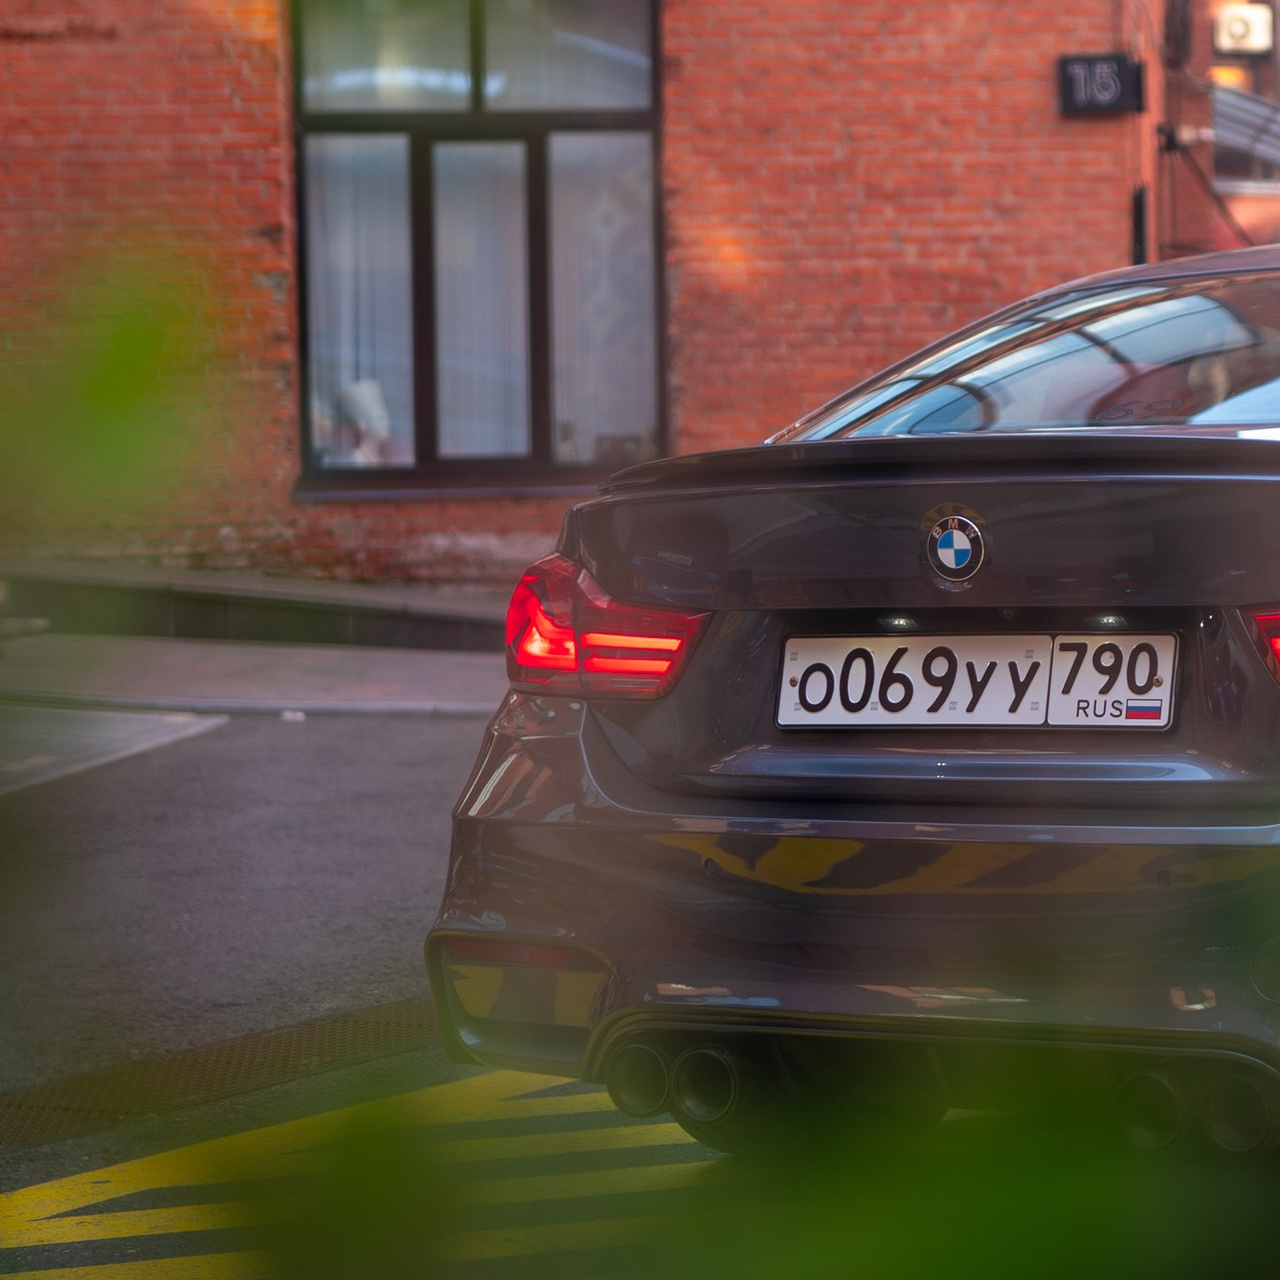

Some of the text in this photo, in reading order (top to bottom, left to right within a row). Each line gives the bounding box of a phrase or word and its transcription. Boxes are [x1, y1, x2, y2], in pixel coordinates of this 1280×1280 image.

[1067, 61, 1121, 106] 15
[932, 518, 978, 540] BMW
[1059, 642, 1158, 695] 790
[1076, 698, 1123, 718] RUS
